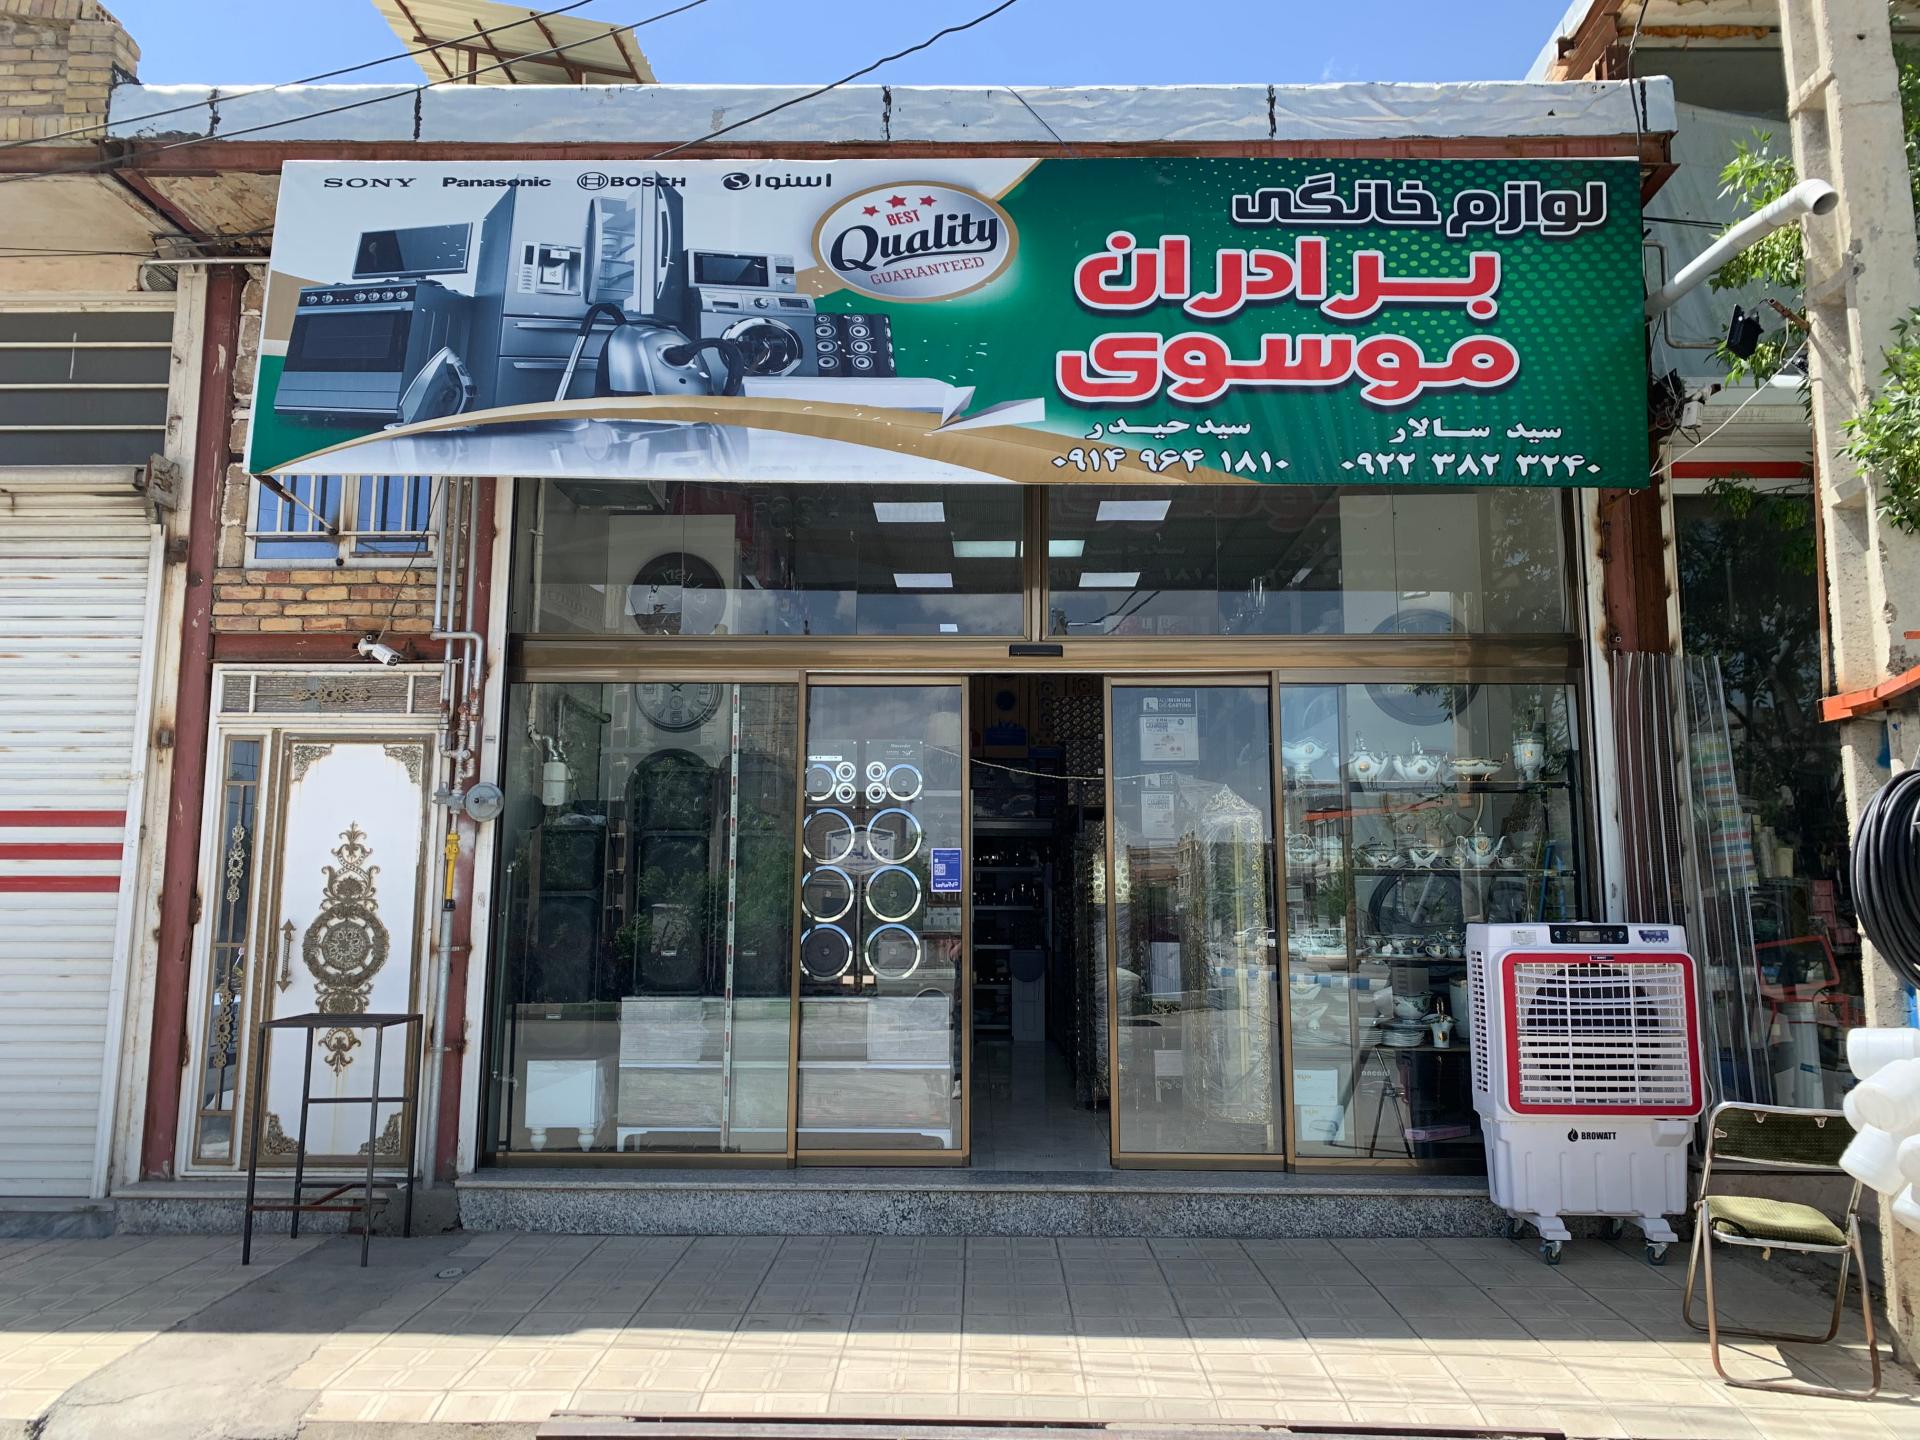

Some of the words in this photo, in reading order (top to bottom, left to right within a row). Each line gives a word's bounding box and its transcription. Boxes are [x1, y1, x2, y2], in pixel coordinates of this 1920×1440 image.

[323, 177, 417, 188] SONY
[442, 176, 552, 188] Panasonic
[610, 176, 686, 188] BOSCH
[754, 173, 832, 190] اسنوا
[1232, 172, 1440, 225] خانگی
[1447, 178, 1607, 237] لوازم
[885, 209, 920, 226] BEST
[830, 213, 998, 271] Quality
[870, 256, 985, 285] GUARANTEED
[1073, 230, 1502, 320] برادران
[1055, 332, 1520, 406] موسوی
[1085, 417, 1190, 440] حیدر
[1196, 418, 1250, 440] سید
[1388, 417, 1491, 443] سالار
[1506, 422, 1562, 443] سید
[1581, 1131, 1616, 1140] BROWATT
